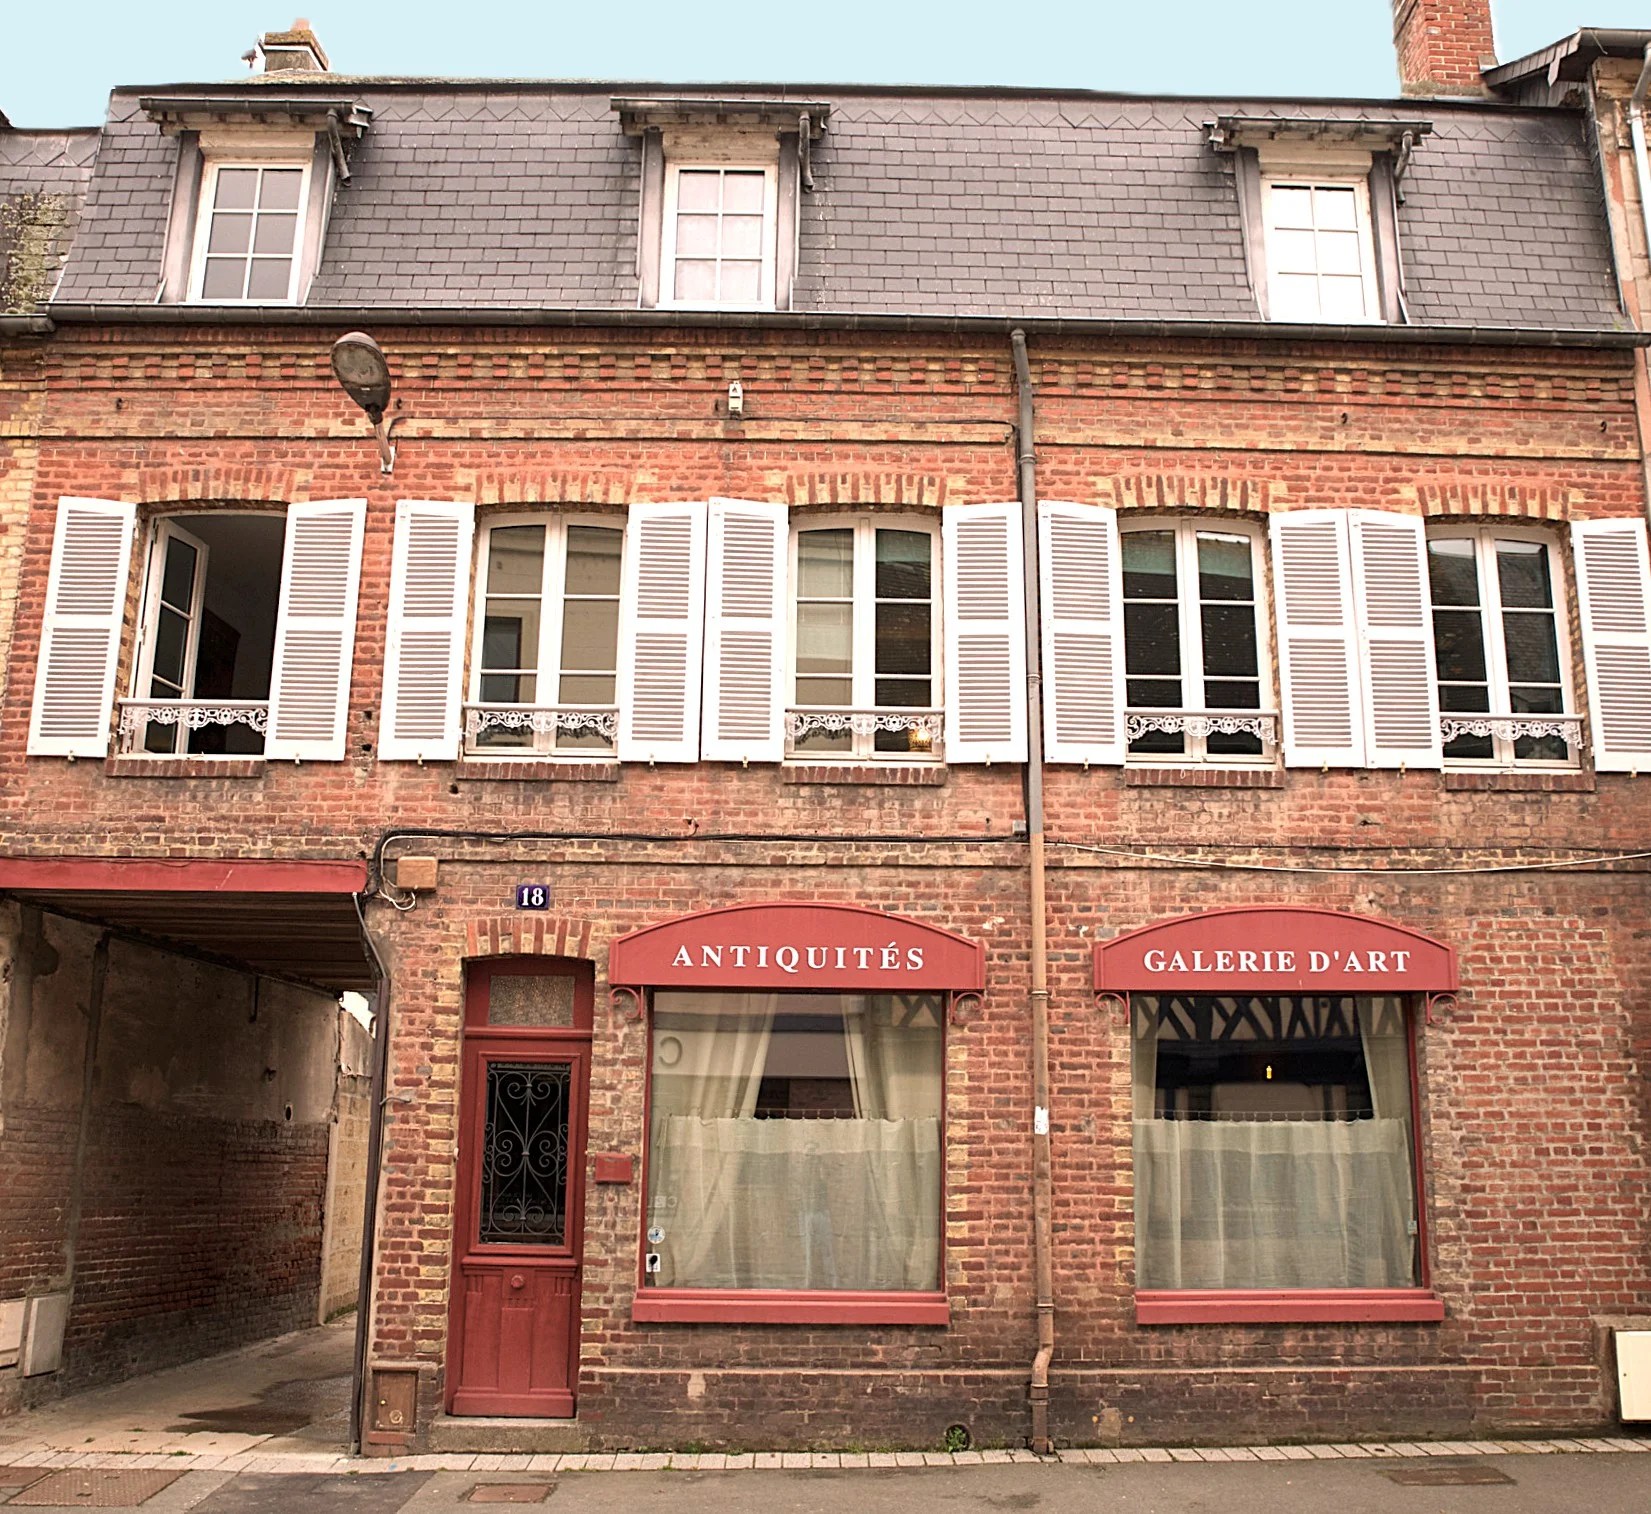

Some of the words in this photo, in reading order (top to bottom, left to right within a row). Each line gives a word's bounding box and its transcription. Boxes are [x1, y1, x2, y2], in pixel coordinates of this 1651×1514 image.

[521, 887, 544, 906] 18
[671, 941, 924, 974] ANTIQUITÉS
[1143, 949, 1297, 973] GALERIE
[1308, 950, 1411, 973] D'ART
